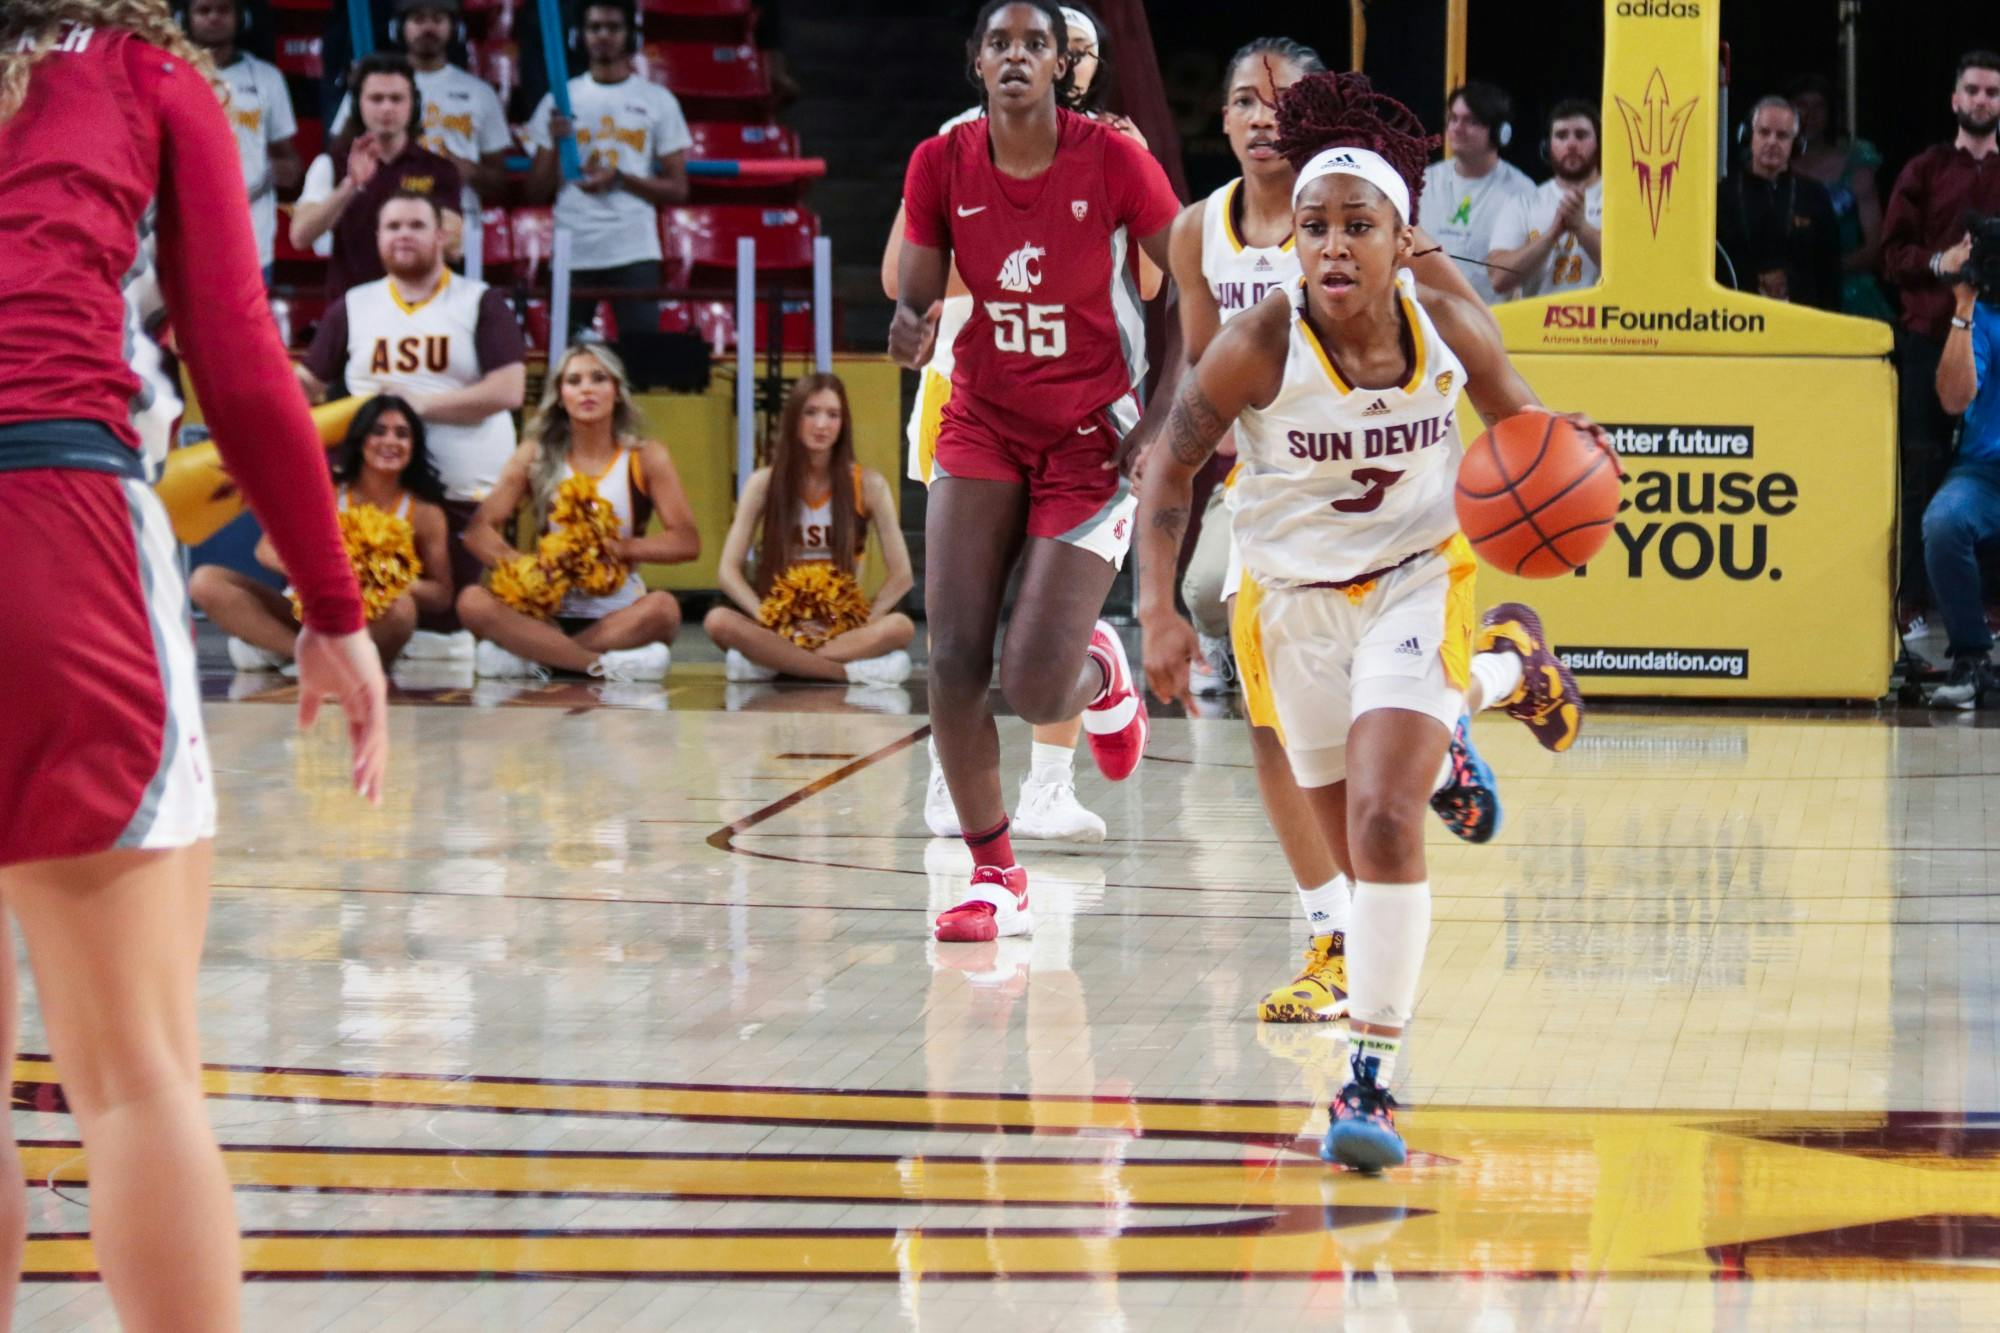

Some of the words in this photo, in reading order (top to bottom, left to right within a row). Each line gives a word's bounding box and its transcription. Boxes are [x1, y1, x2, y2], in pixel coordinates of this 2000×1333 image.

[1616, 0, 1700, 18] adidas
[984, 300, 1068, 358] 55
[1543, 305, 1596, 328] ASU
[1601, 305, 1765, 332] Foundation
[370, 335, 450, 374] ASU
[1542, 335, 1581, 345] Arizona
[1582, 336, 1609, 346] State
[1610, 337, 1660, 349] University
[1287, 430, 1353, 462] SUN
[1605, 427, 1663, 453] etter
[1667, 428, 1748, 454] future
[1614, 521, 1782, 581] YOU.
[1560, 649, 1744, 675] asufoundation.org
